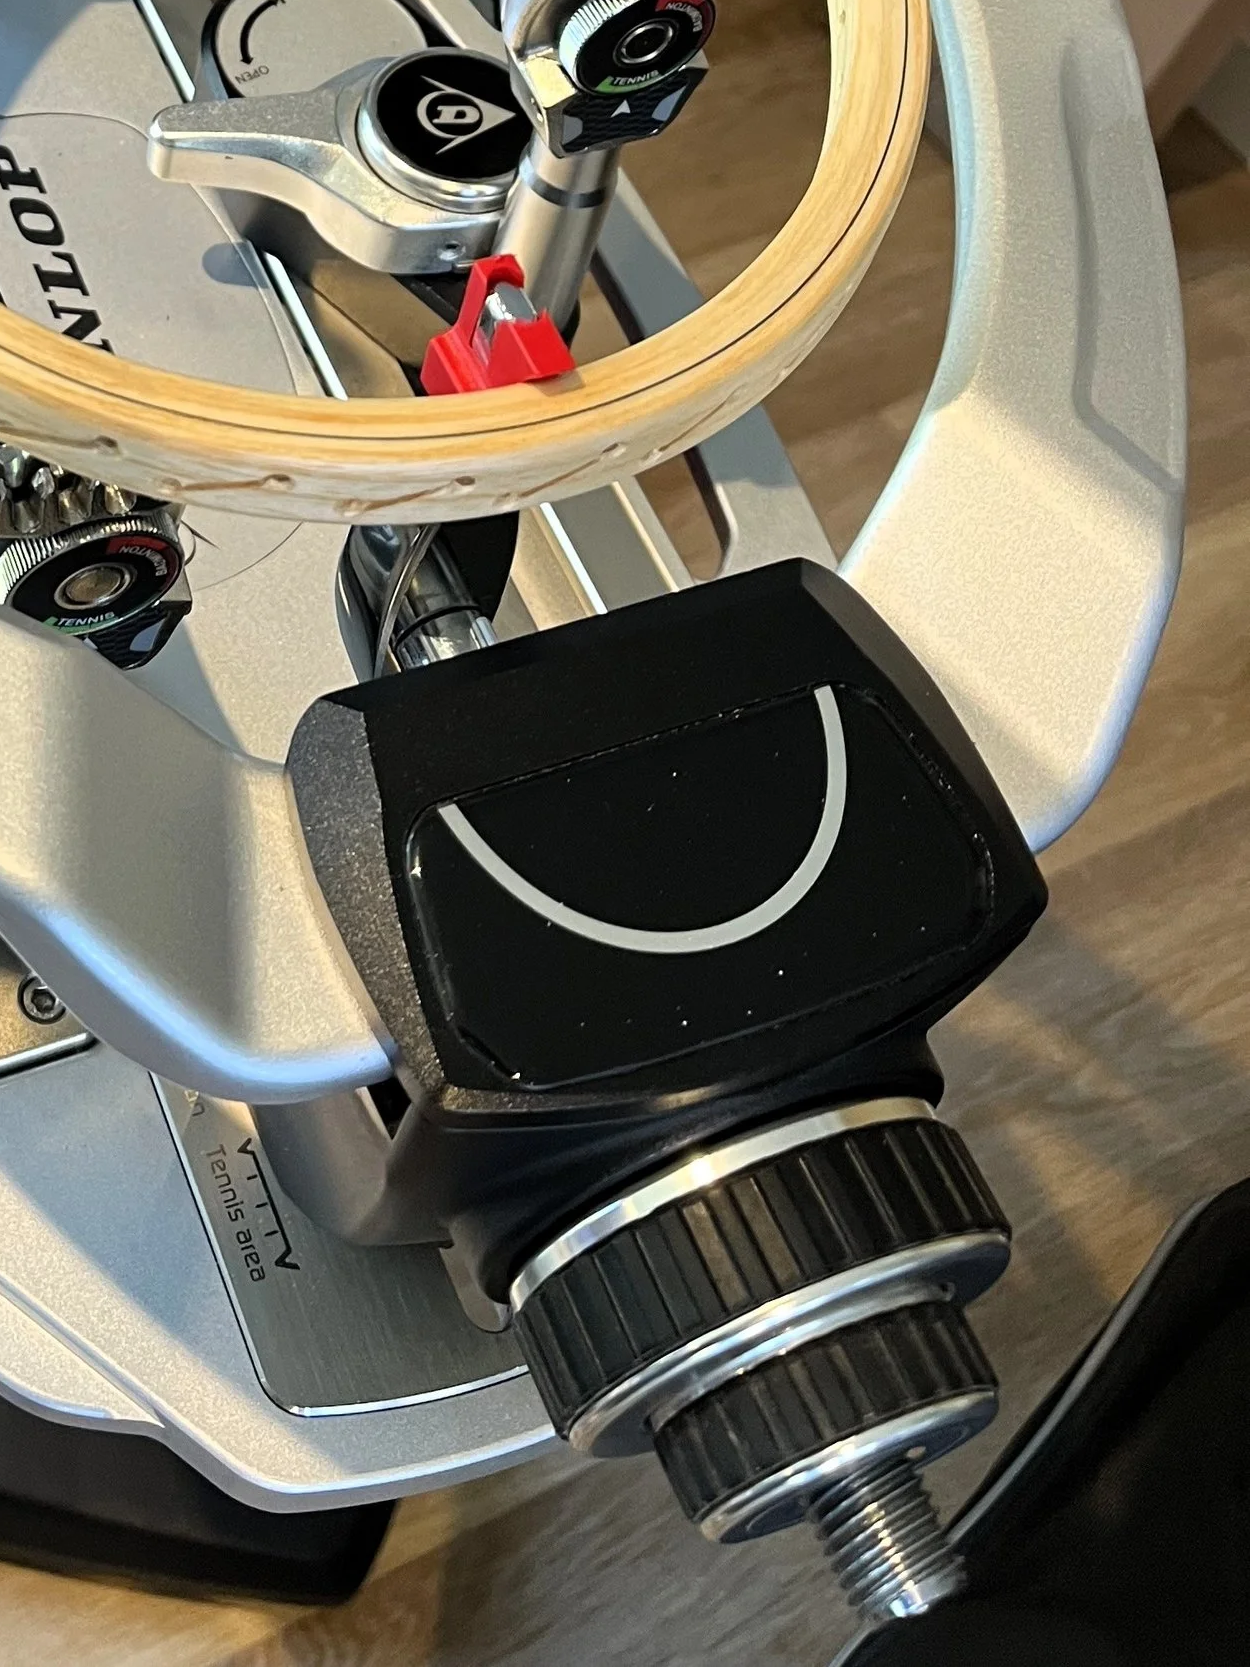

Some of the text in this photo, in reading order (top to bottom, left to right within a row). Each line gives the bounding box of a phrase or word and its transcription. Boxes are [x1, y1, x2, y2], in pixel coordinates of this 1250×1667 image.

[234, 64, 270, 84] OPEN
[613, 69, 660, 86] TENNIS
[58, 611, 116, 627] TENNIS
[206, 1144, 265, 1282] Tennis area
